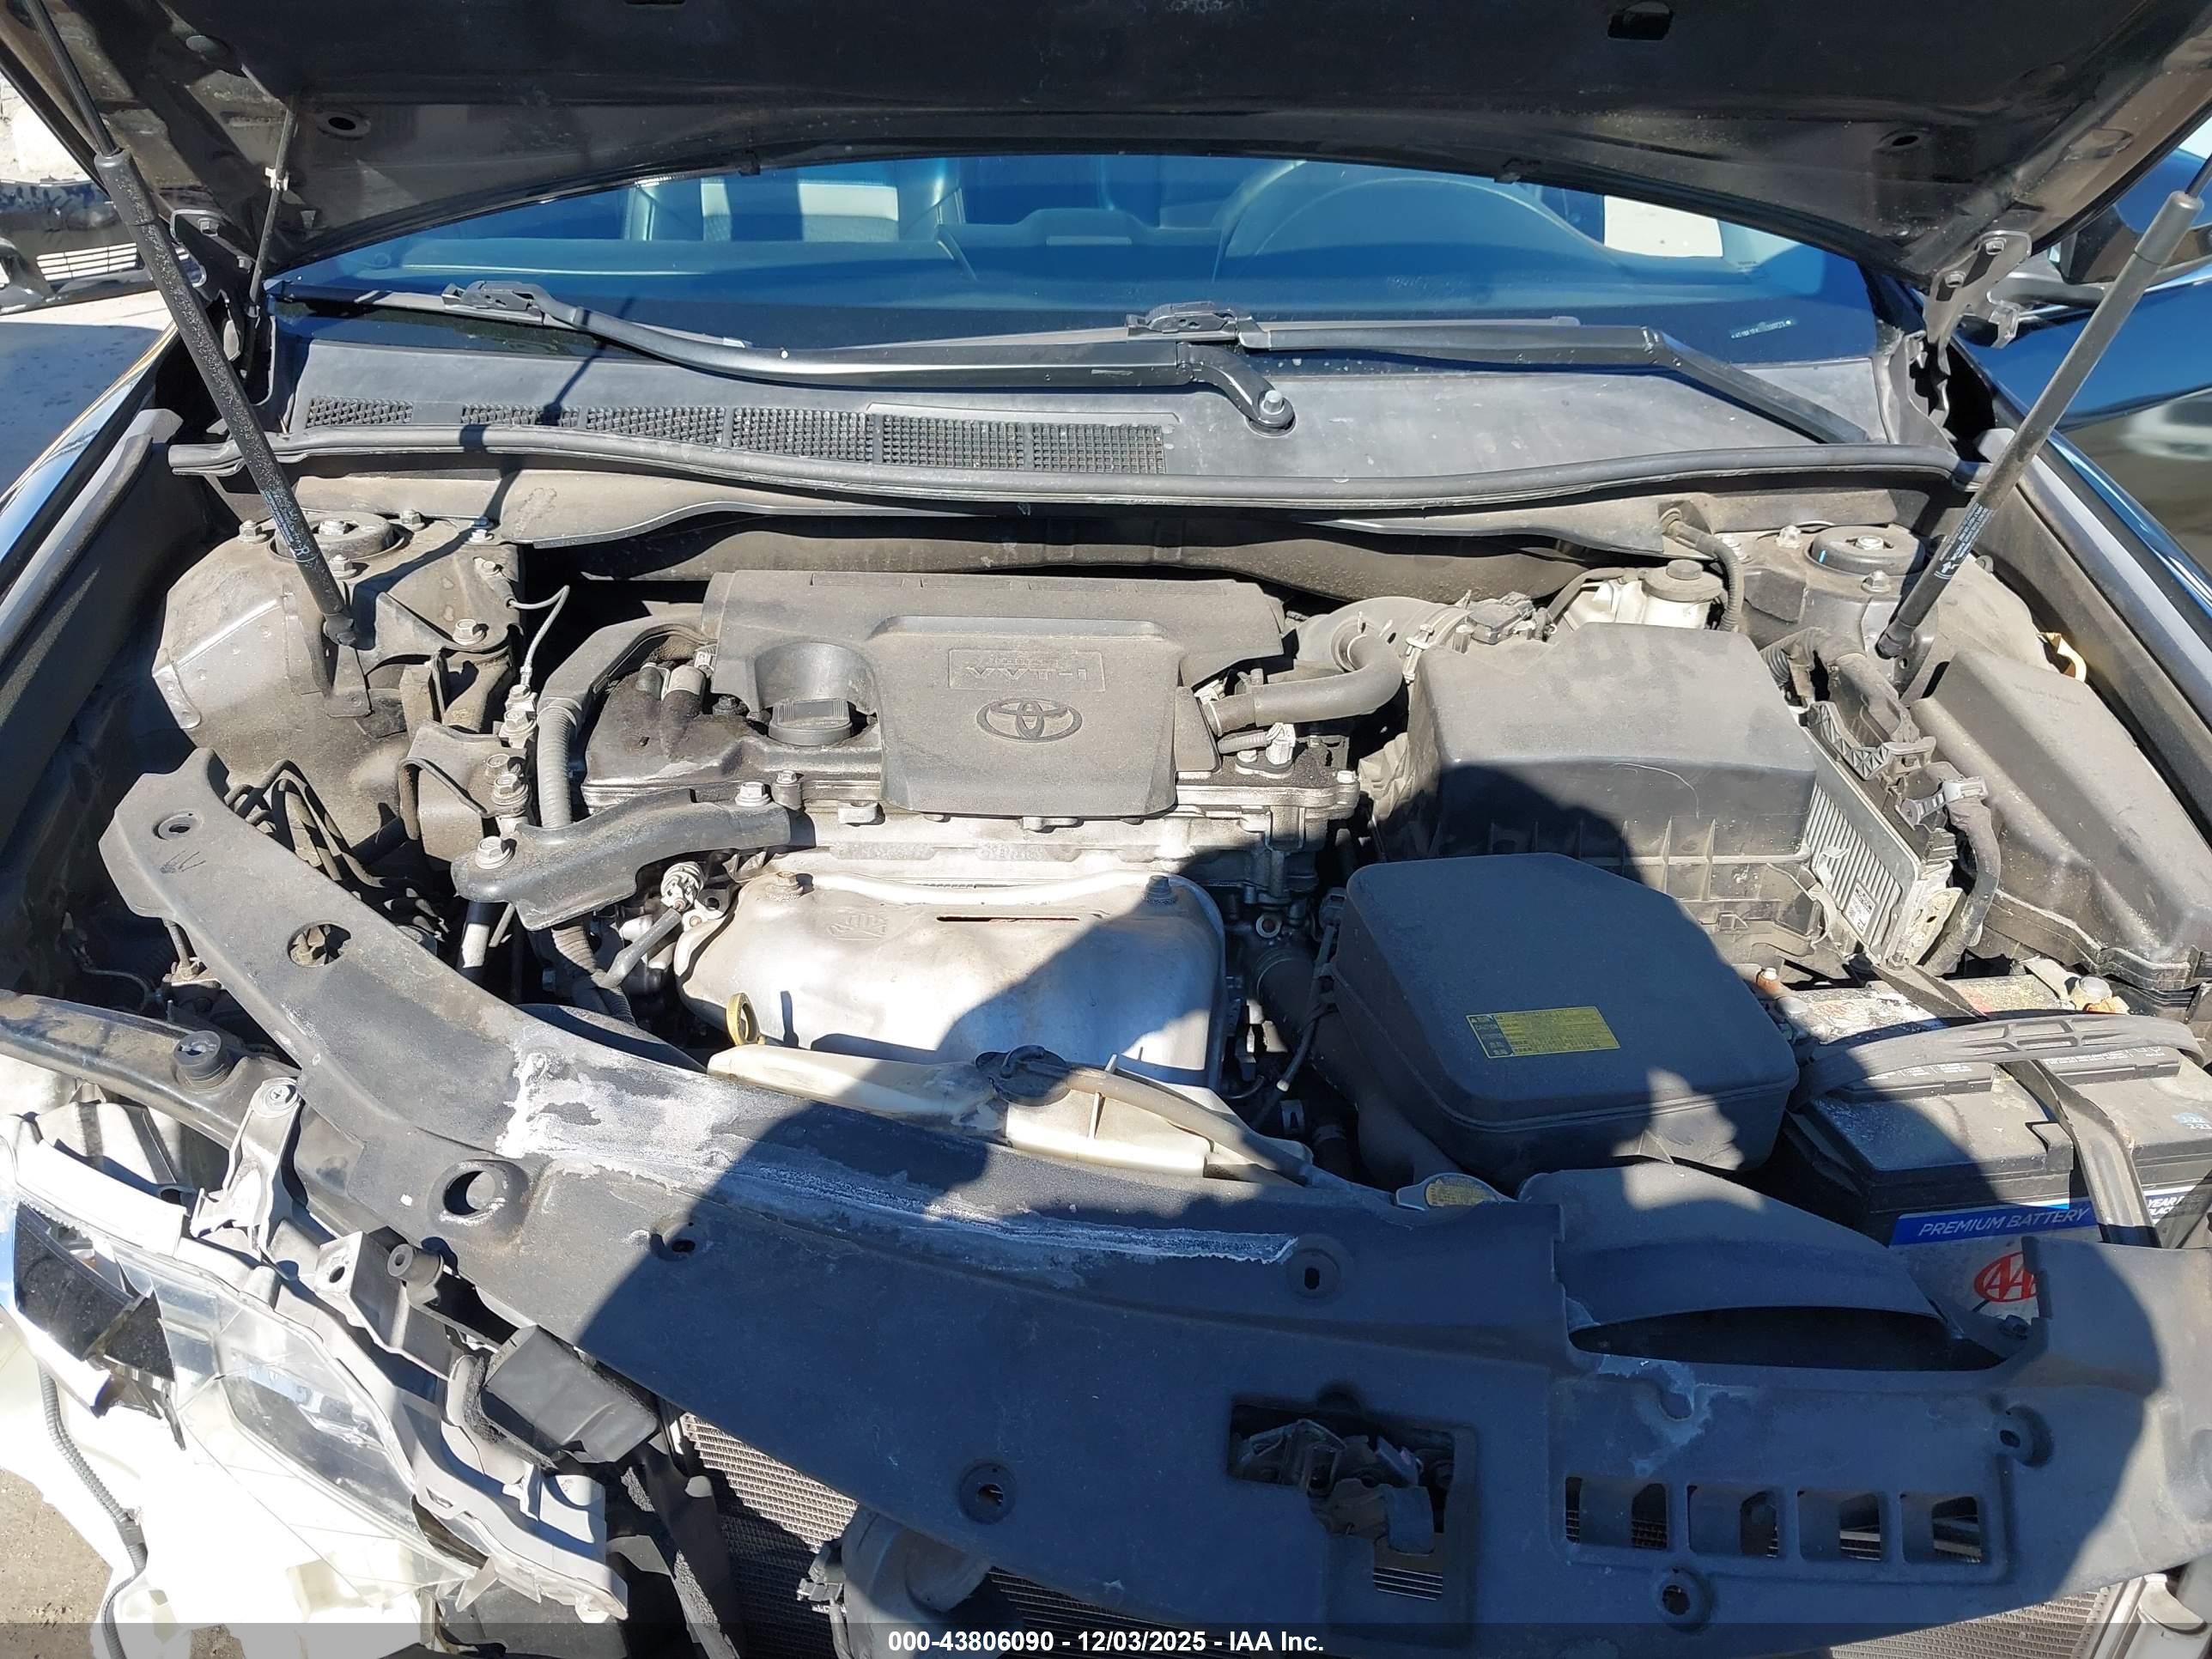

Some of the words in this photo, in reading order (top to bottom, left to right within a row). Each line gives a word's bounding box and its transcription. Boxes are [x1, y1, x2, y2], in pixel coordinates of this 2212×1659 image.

[2148, 1196, 2178, 1209] YEAR
[1917, 1215, 2008, 1237] PREMIUM
[2006, 1206, 2091, 1229] BATTERY
